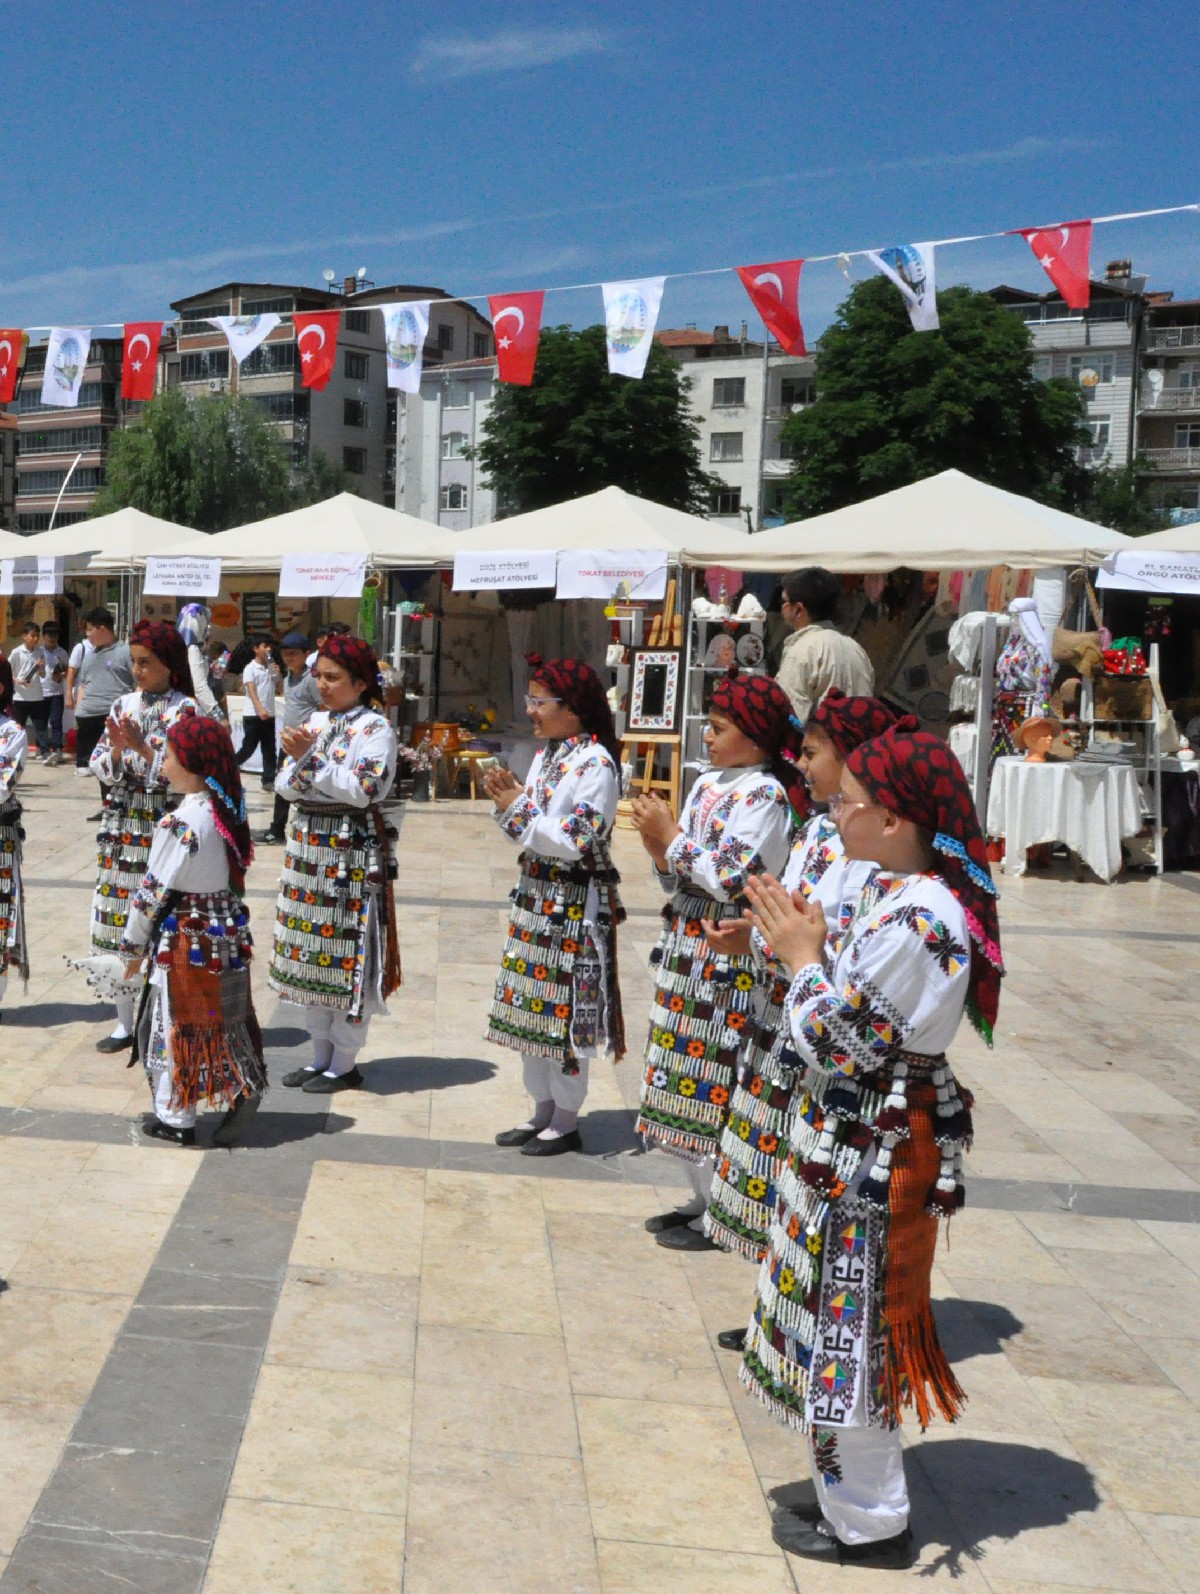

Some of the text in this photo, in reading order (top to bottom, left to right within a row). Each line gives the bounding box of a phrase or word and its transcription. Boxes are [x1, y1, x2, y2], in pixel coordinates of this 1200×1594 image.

[499, 561, 529, 570] ATÖLYESİ
[603, 569, 644, 577] BELEDİYESİ
[1137, 569, 1169, 578] ÖRGÜ
[470, 574, 538, 584] MEFRUŞAT ATÖLYESİ
